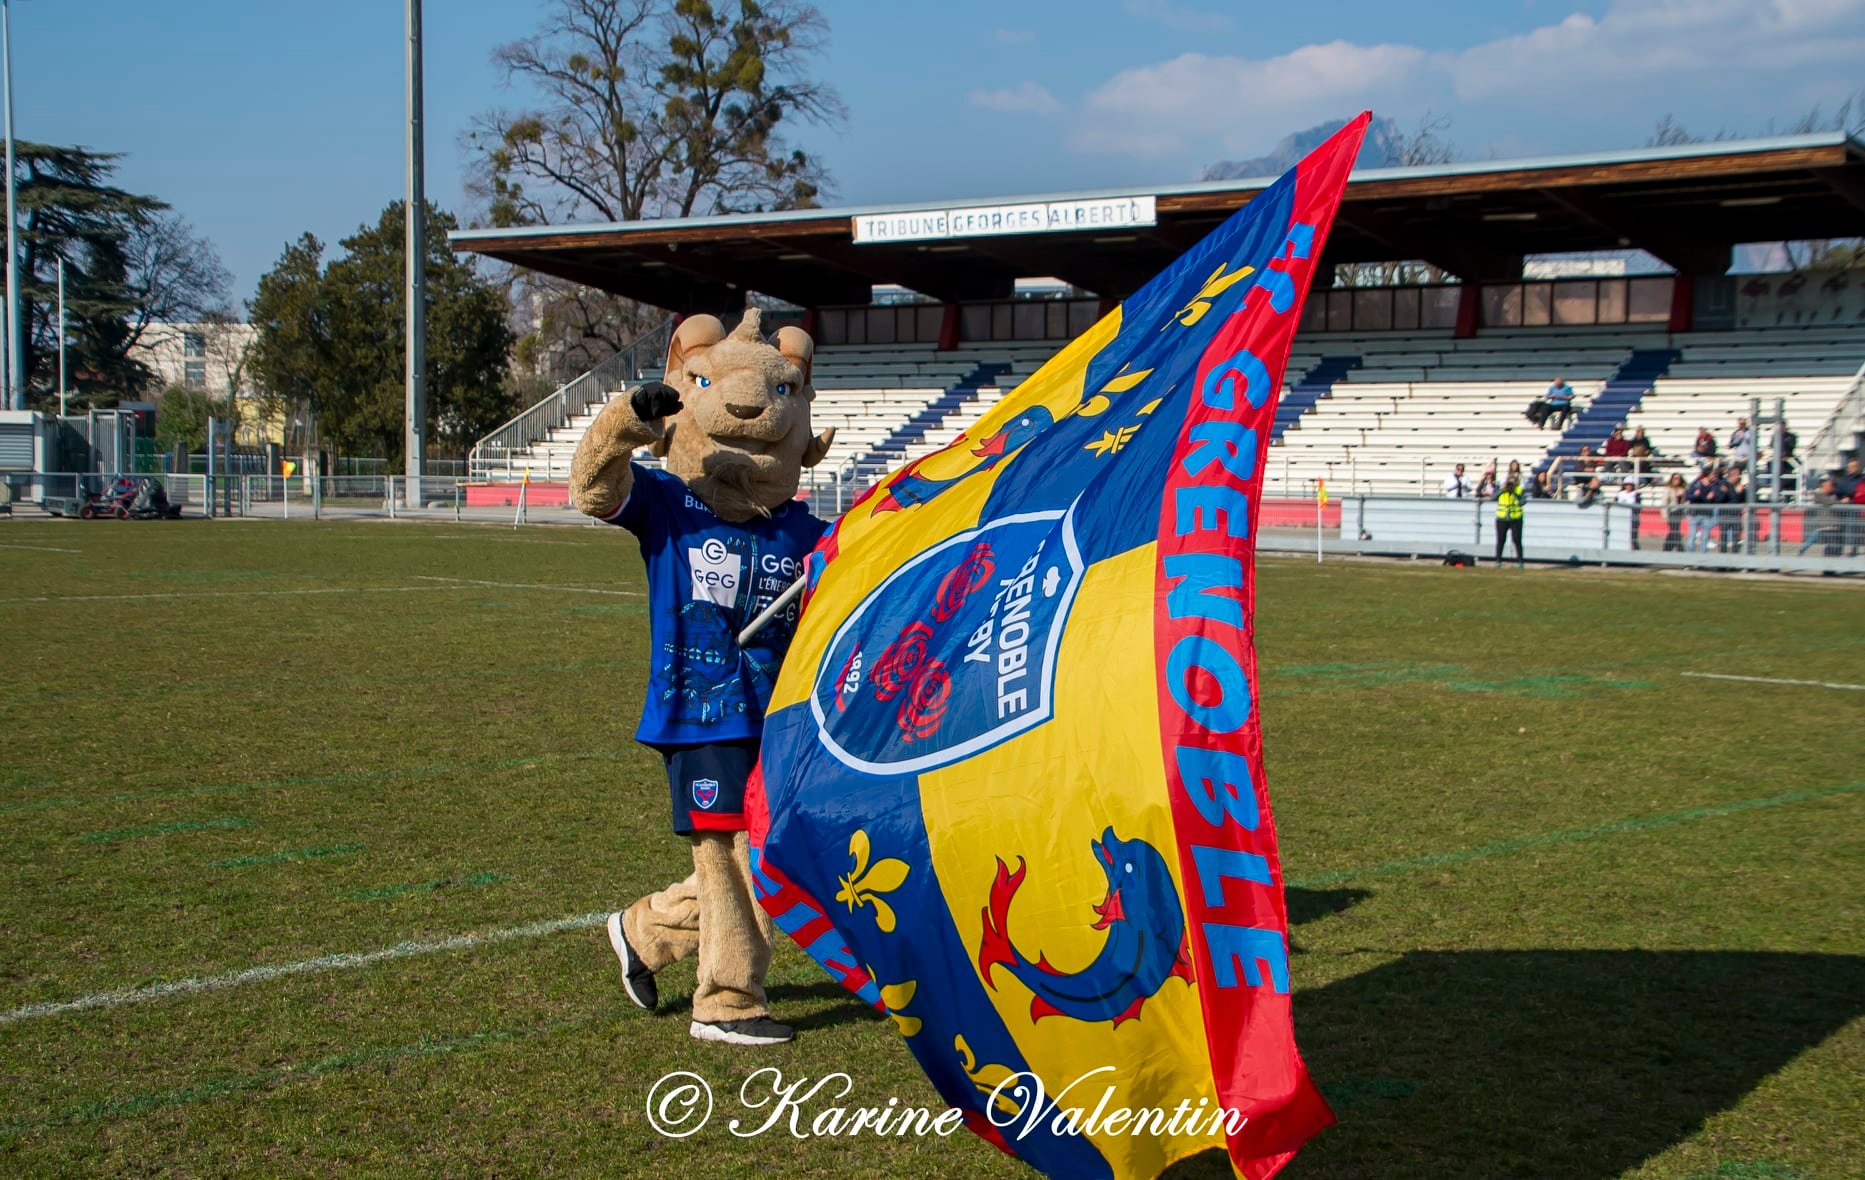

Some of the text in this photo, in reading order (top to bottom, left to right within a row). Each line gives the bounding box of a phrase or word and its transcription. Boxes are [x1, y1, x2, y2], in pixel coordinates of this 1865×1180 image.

[865, 217, 946, 236] TRIBUNE
[953, 210, 1041, 232] GEORGES
[998, 539, 1047, 719] RENOBLE
[1163, 348, 1290, 994] GRENOBLE
